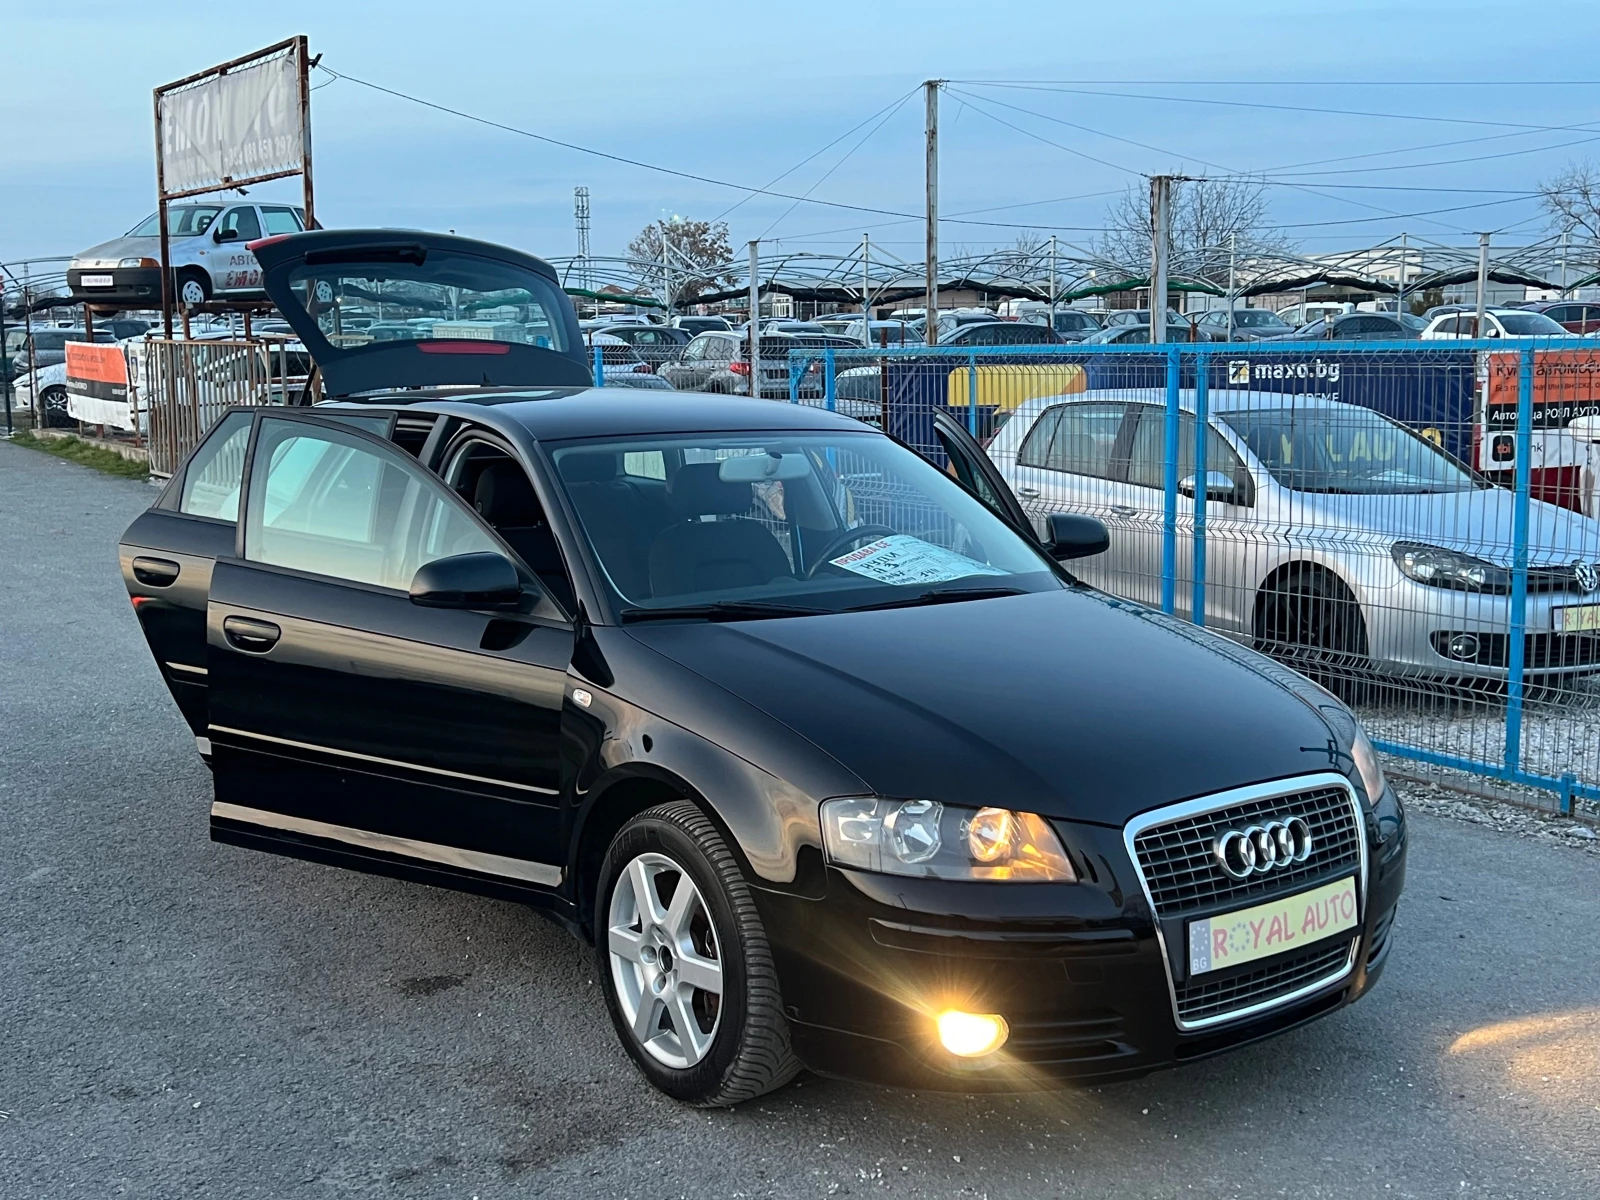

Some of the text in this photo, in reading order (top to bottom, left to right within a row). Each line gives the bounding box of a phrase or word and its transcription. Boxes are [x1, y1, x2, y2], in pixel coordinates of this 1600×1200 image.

[1255, 358, 1340, 382] maxo.bg
[1496, 443, 1511, 454] tbi
[834, 547, 879, 566] ПРОДАВА
[878, 540, 892, 549] СЕ
[1212, 889, 1355, 960] ROYAL AUTO
[1192, 957, 1207, 971] BG
